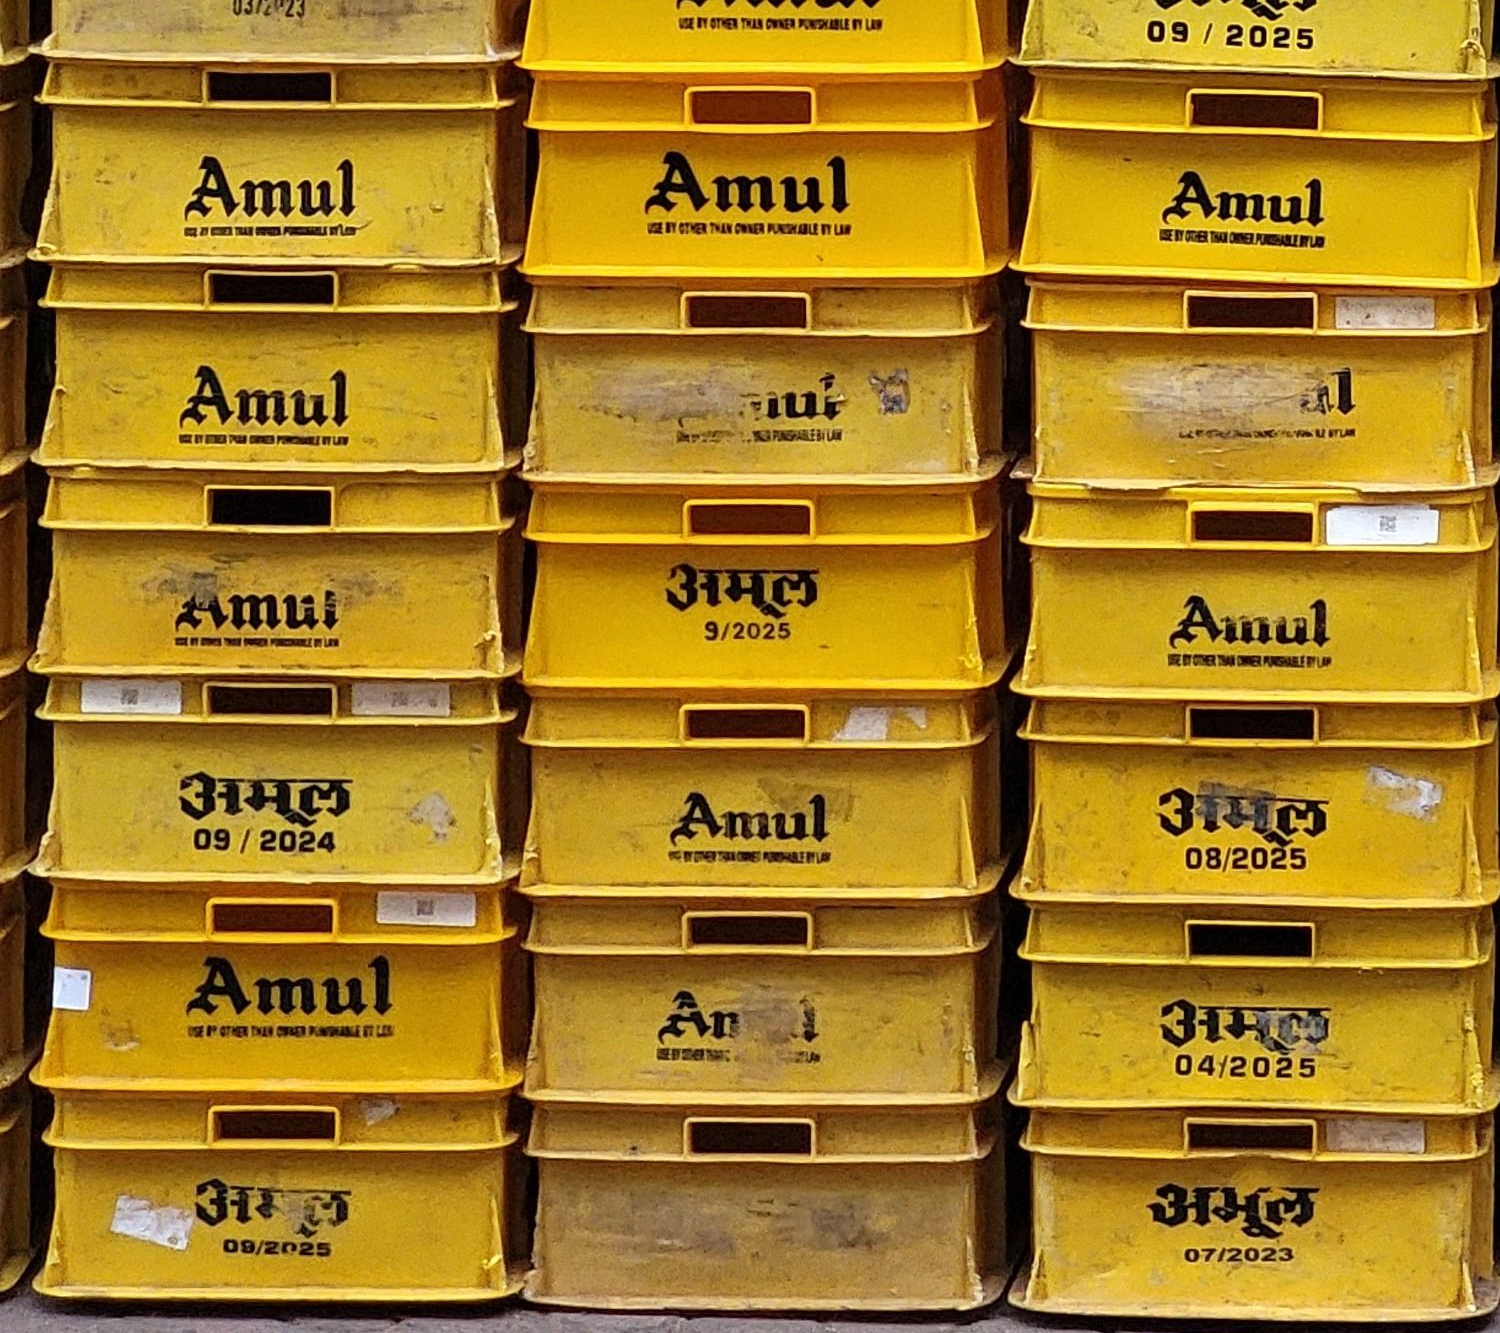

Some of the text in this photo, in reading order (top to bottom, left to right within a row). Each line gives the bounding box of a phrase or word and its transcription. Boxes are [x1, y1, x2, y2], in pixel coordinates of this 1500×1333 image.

[678, 17, 694, 30] USE
[741, 18, 763, 31] THAN
[866, 19, 883, 32] LAW
[1146, 20, 1190, 44] 09
[1226, 24, 1315, 50] 2025
[184, 154, 356, 221] Amul
[645, 151, 850, 213] Amul
[1162, 170, 1324, 227] Amul
[179, 365, 348, 427] Amul
[666, 563, 821, 618] अमूल
[704, 622, 791, 641] 9/2025
[1169, 594, 1331, 649] Amul
[178, 770, 353, 826] अमूल
[670, 791, 826, 844] Amul
[1159, 787, 1329, 845] अमूल
[193, 828, 232, 851] 09
[259, 830, 336, 853] 2024
[1185, 847, 1307, 871] 08/2025
[187, 956, 393, 1014] Amul
[1160, 999, 1329, 1053] अमूल
[1175, 1056, 1316, 1079] 04/2025
[1151, 1183, 1321, 1238] अमूल
[1184, 1247, 1294, 1264] 07/2023
